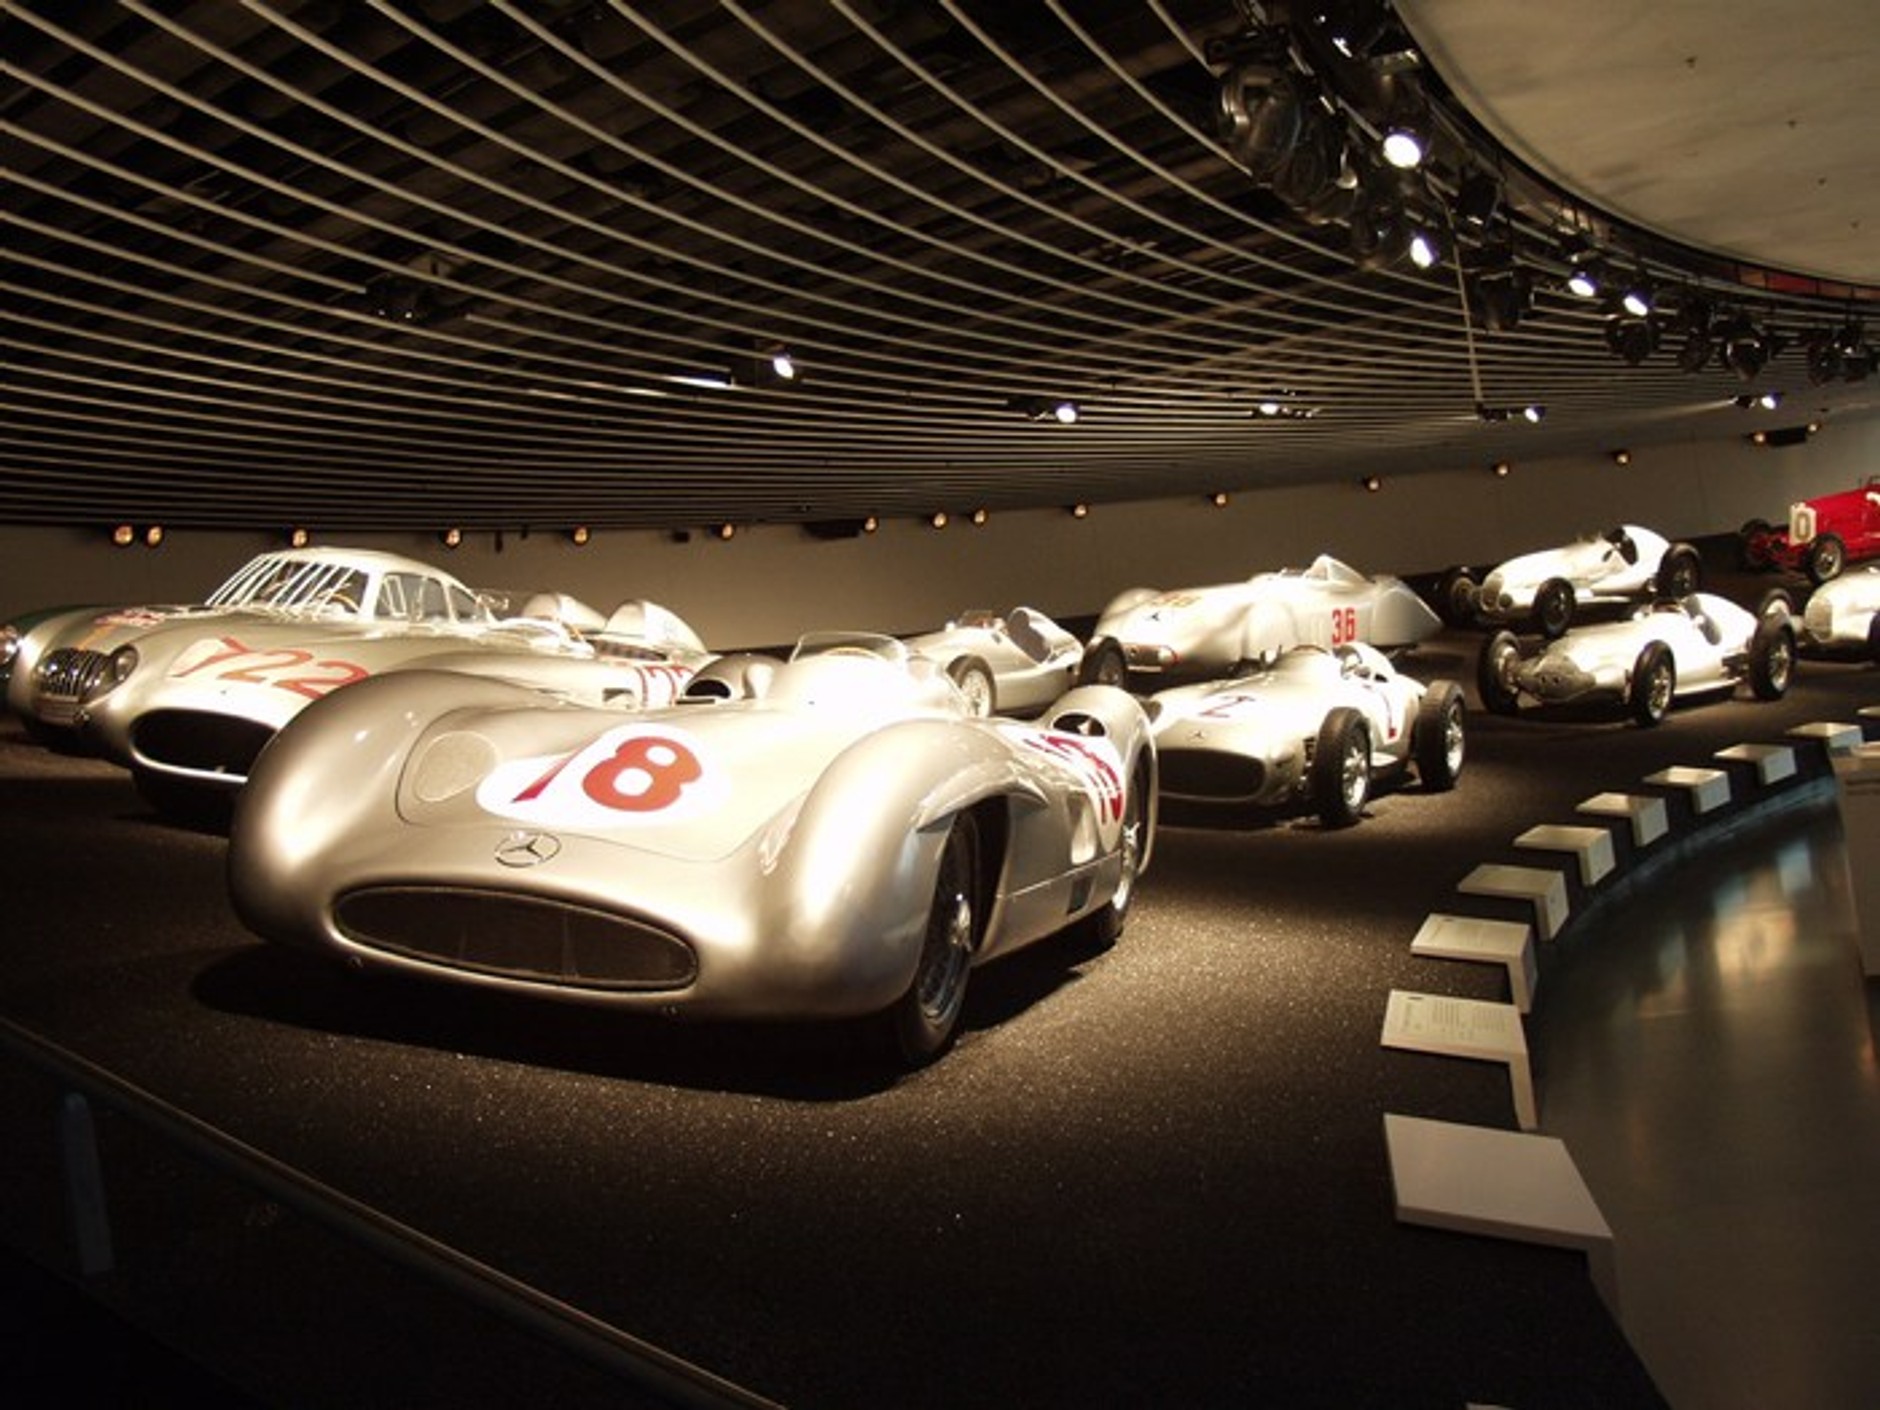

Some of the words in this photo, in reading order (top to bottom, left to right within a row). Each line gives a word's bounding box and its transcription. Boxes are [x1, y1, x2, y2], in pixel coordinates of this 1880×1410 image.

[1331, 607, 1355, 644] 36
[168, 630, 369, 701] 722
[509, 728, 703, 813] 18
